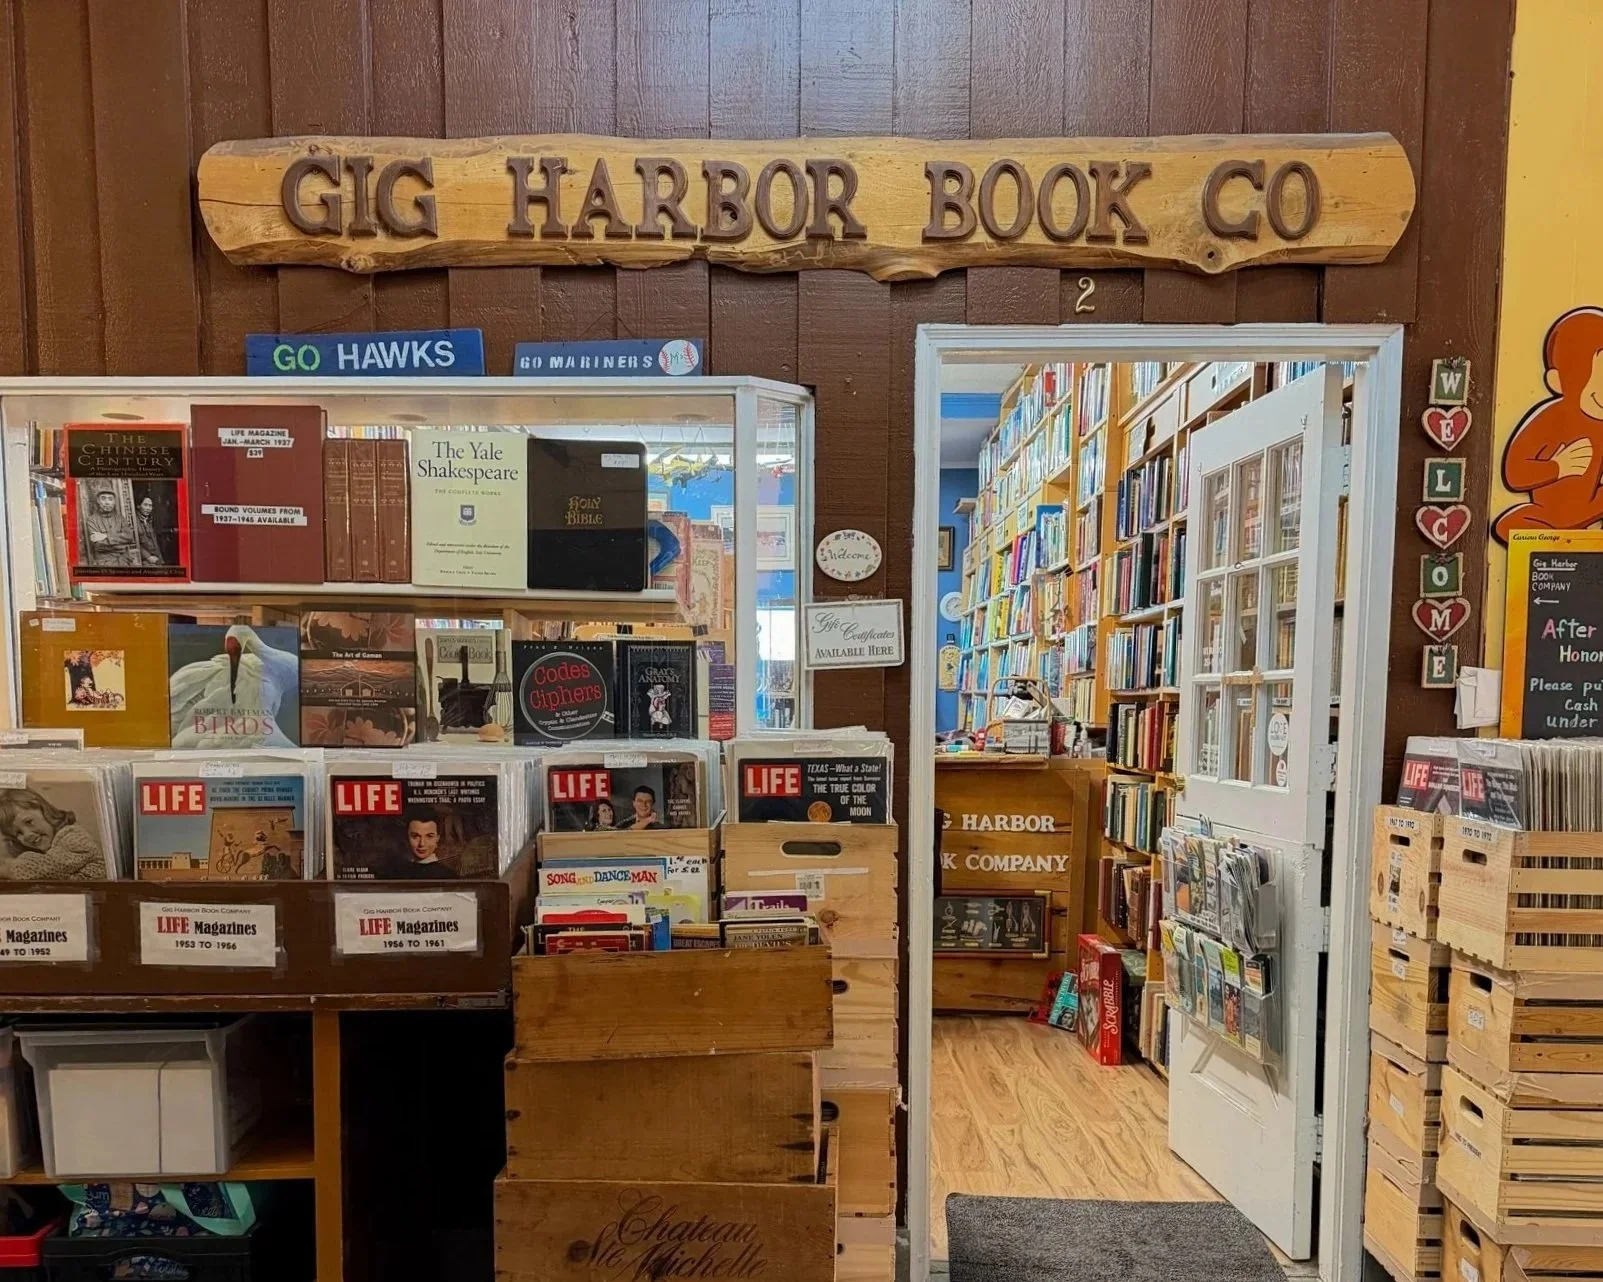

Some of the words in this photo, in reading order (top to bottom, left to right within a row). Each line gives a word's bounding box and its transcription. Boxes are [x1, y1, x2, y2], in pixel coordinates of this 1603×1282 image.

[281, 156, 438, 239] GIG
[507, 157, 867, 241] HARBOR
[922, 159, 1150, 244] BOOK
[1203, 159, 1321, 240] CO
[1074, 277, 1096, 313] 2
[273, 344, 321, 371] GO
[337, 341, 455, 370] HAWKS
[520, 356, 542, 369] GO
[550, 355, 653, 369] MARINERS
[104, 432, 147, 444] THE
[82, 444, 170, 455] CHINESE
[432, 441, 464, 459] The
[469, 442, 503, 460] Yale
[78, 455, 174, 466] CENTURY
[417, 459, 519, 485] Shakespeare
[568, 496, 602, 511] HOLY
[565, 511, 603, 525] BIBLE
[1513, 533, 1538, 541] Curious
[1538, 534, 1560, 542] George
[827, 548, 872, 560] Welcome
[1551, 558, 1578, 568] Harbor
[1532, 571, 1554, 581] BOOK
[1532, 582, 1571, 592] COMPANY
[812, 612, 840, 634] Gift
[1541, 618, 1597, 639] After
[840, 622, 895, 642] Certificates
[815, 647, 866, 659] AVAILABLE
[868, 645, 894, 656] HERE
[534, 661, 590, 685] Codes
[639, 674, 681, 683] ANATOMY
[644, 667, 675, 676] GRAY'S
[1530, 678, 1573, 692] Please
[530, 684, 602, 711] Ciphers
[1565, 698, 1598, 711] Cash
[194, 708, 227, 716] ROBERT
[230, 708, 272, 716] BATEMAN
[561, 709, 578, 717] Other
[193, 715, 274, 736] BIRDS
[1546, 716, 1599, 728] under
[860, 763, 881, 773] State!
[1404, 762, 1430, 788] LIFE
[553, 773, 609, 798] LIFE
[747, 767, 799, 794] LIFE
[1462, 770, 1485, 798] LIFE
[813, 784, 828, 794] THE
[830, 784, 849, 793] TRUE
[851, 783, 876, 793] COLOR
[143, 785, 203, 812] LIFE
[337, 784, 399, 811] LIFE
[840, 795, 850, 805] OF
[853, 795, 867, 805] THE
[850, 807, 872, 817] MOON
[962, 813, 1056, 832] HARBOR
[1462, 826, 1472, 836] 1970
[1474, 829, 1480, 838] TO
[1482, 829, 1492, 840] 1972
[965, 854, 1069, 872] COMPANY
[546, 872, 576, 886] SONG
[575, 874, 593, 885] AND
[593, 869, 632, 883] DANCE
[631, 870, 658, 883] MAN
[157, 916, 190, 934] LIFE
[194, 921, 257, 936] Magazines
[359, 917, 392, 936] LIFE
[396, 919, 459, 935] Magazines
[6, 929, 68, 944] Magazines
[383, 940, 404, 948] 1956
[425, 939, 445, 947] 1961
[13, 948, 26, 956] TO
[31, 947, 51, 956] 1952
[175, 940, 196, 948] 1953
[199, 941, 212, 949] TO
[216, 942, 237, 950] 1956
[1103, 979, 1119, 1034] SCRABBLE
[618, 1188, 759, 1246] Chateau
[612, 1240, 769, 1282] Michelle
